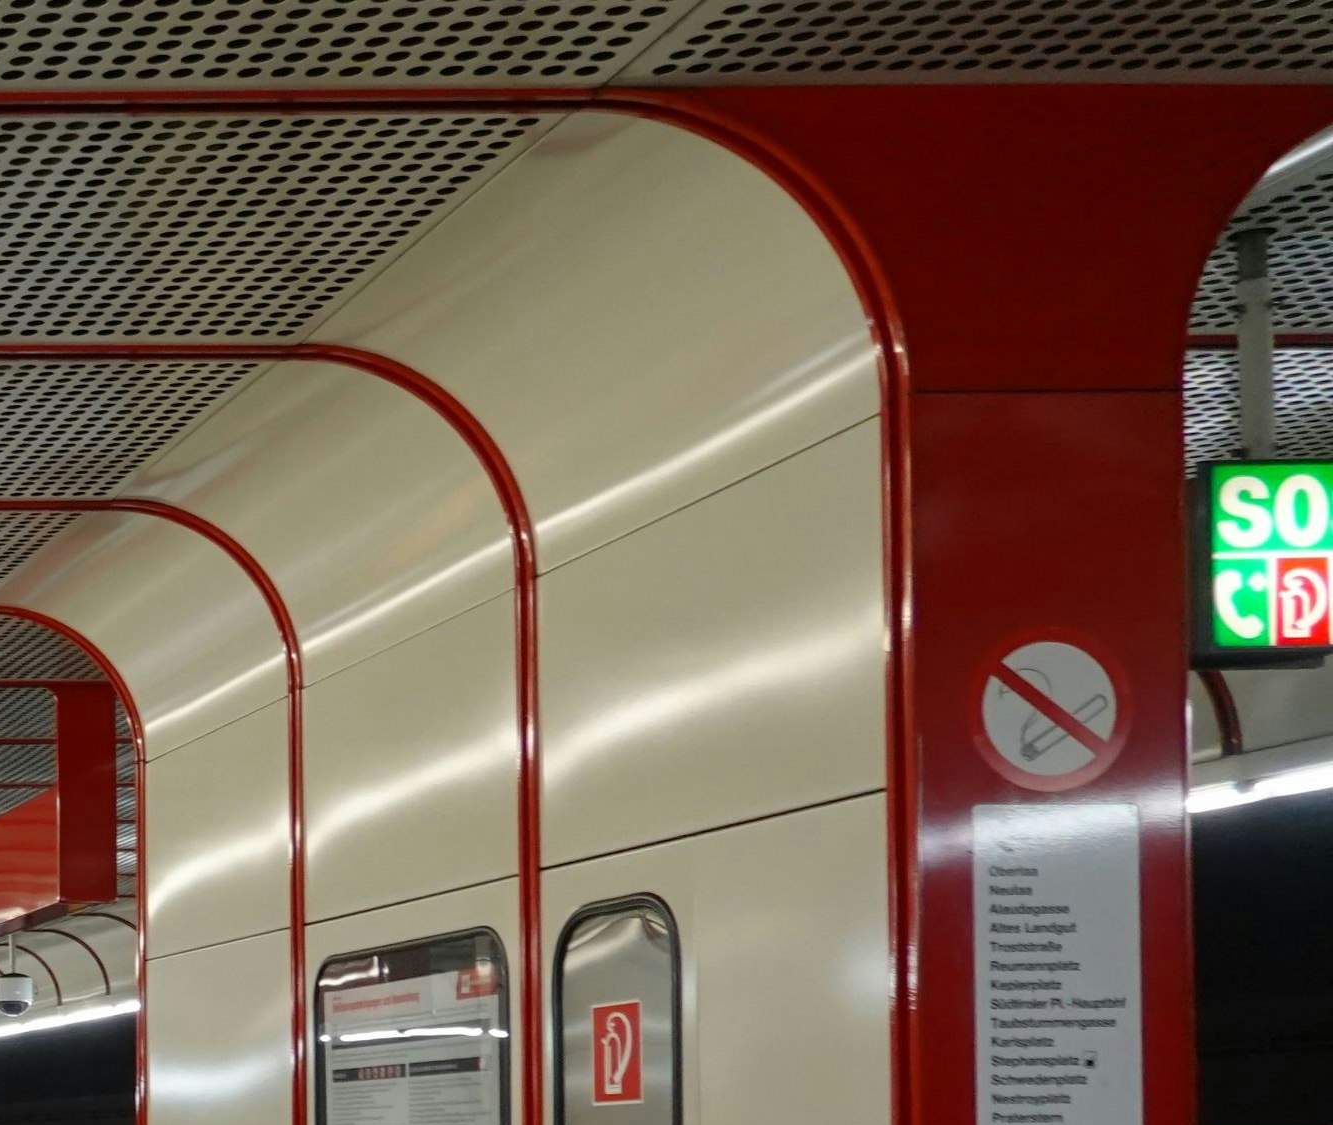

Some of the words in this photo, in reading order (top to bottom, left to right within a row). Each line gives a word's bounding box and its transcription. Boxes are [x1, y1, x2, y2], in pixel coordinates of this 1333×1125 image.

[1217, 473, 1333, 549] SO
[988, 884, 1034, 898] Neulaa
[989, 903, 1071, 918] Alaudagasse
[989, 922, 1021, 936] Altes
[1024, 922, 1078, 937] Landgut
[989, 940, 1064, 954] Troststraße
[989, 960, 1081, 975] Reumannplatz
[989, 979, 1063, 994] Keplerplatz
[989, 997, 1048, 1011] Südtiroler
[990, 1016, 1118, 1031] Taubstummengasse
[990, 1035, 1055, 1050] Karlsplatz
[990, 1053, 1081, 1069] Stephansplatz
[990, 1073, 1089, 1088] Schwedenplatz
[991, 1092, 1073, 1108] Nestroyplatz
